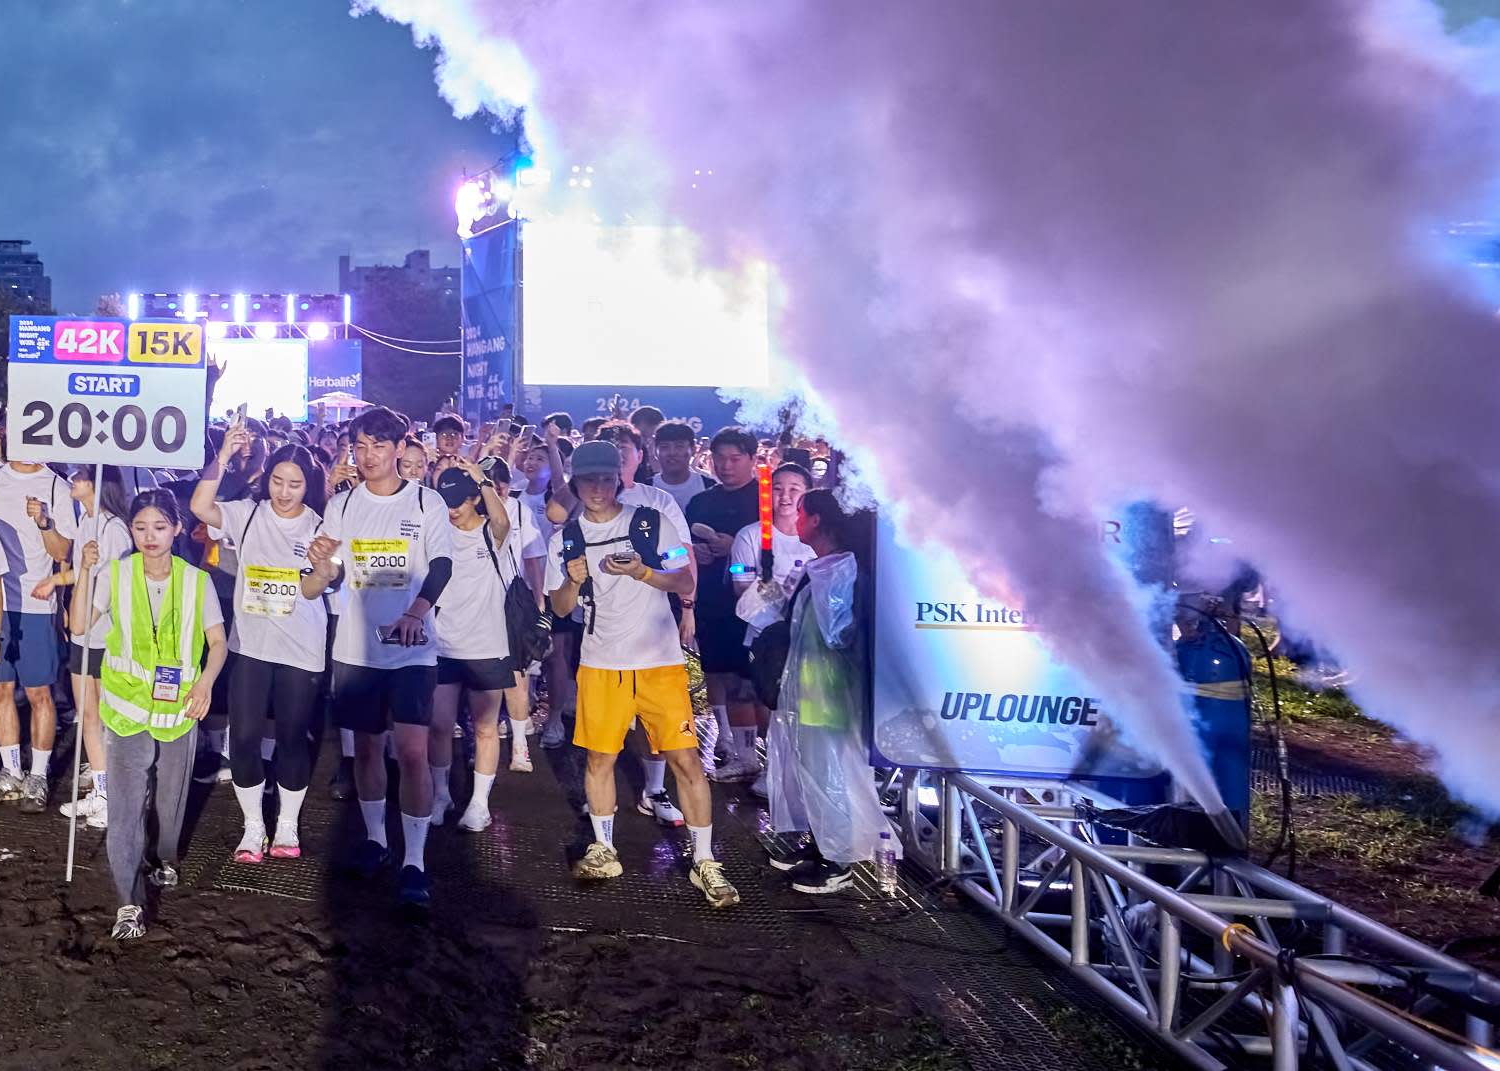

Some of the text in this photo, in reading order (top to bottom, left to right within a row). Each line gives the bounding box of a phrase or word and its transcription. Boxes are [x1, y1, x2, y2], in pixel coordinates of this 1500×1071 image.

[57, 328, 120, 355] 42K
[138, 331, 193, 356] 15K
[74, 375, 134, 393] START
[309, 376, 357, 388] Herbalife
[22, 400, 187, 454] 20:00
[370, 556, 406, 568] 20:00
[263, 583, 297, 596] 20:00
[916, 602, 968, 622] PSK
[940, 692, 1100, 726] UPLOUNGE
